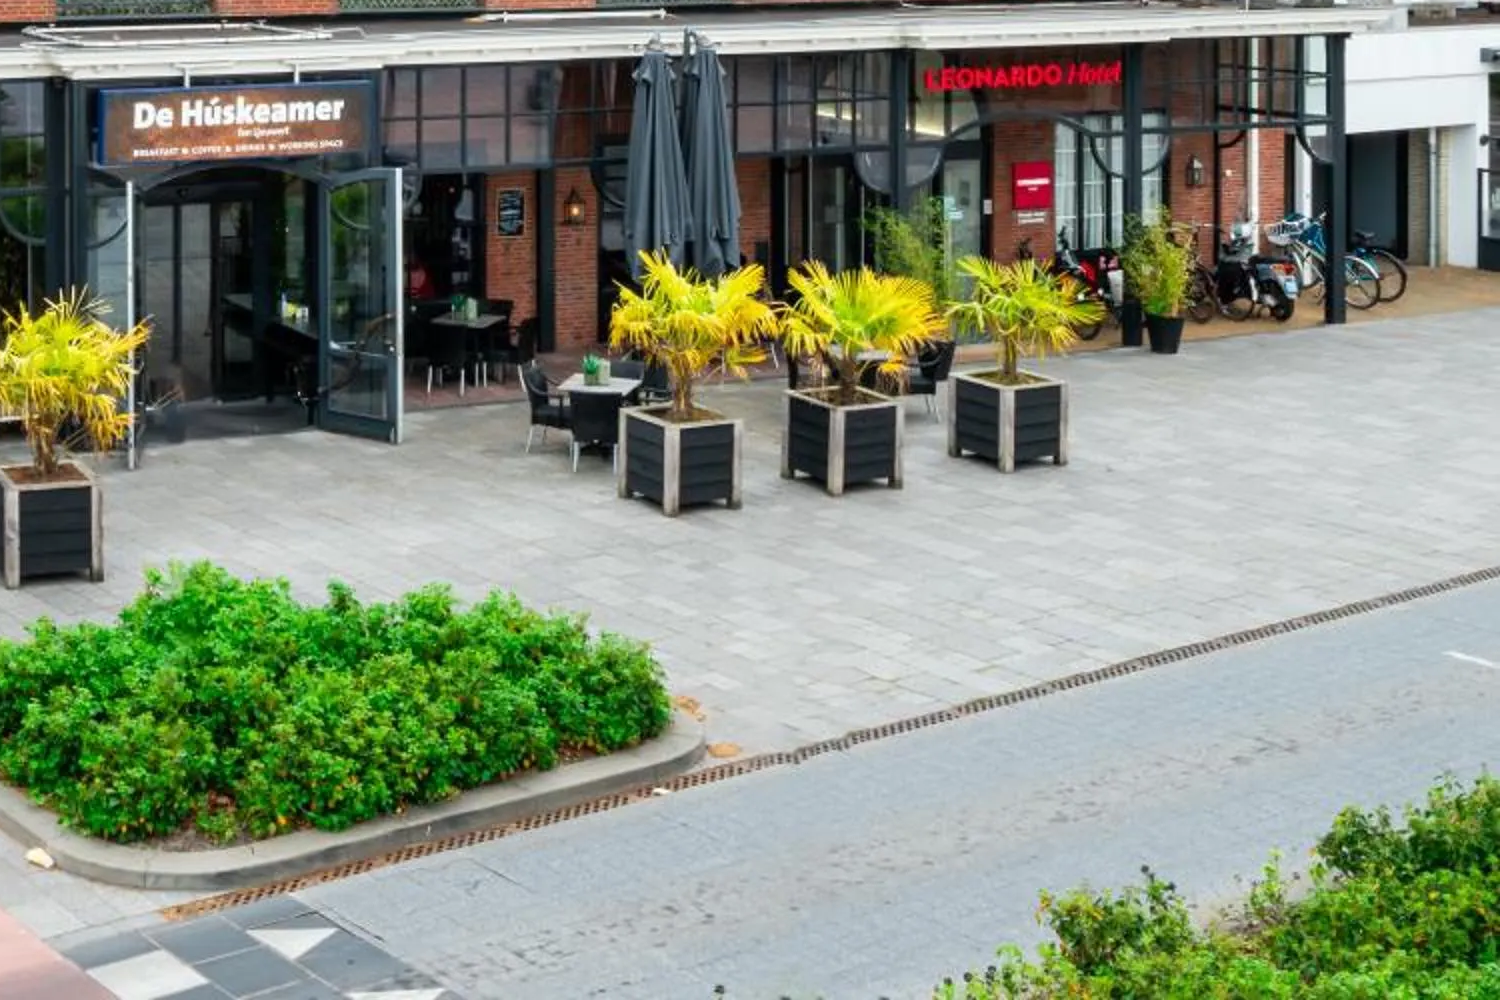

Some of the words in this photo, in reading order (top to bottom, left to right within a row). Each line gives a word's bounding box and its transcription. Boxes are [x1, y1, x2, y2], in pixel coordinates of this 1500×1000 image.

[925, 65, 1063, 90] LEONARDO
[1066, 60, 1122, 84] Hotel
[133, 102, 174, 129] De
[181, 96, 345, 127] Húskeamer
[320, 138, 344, 149] SPACE
